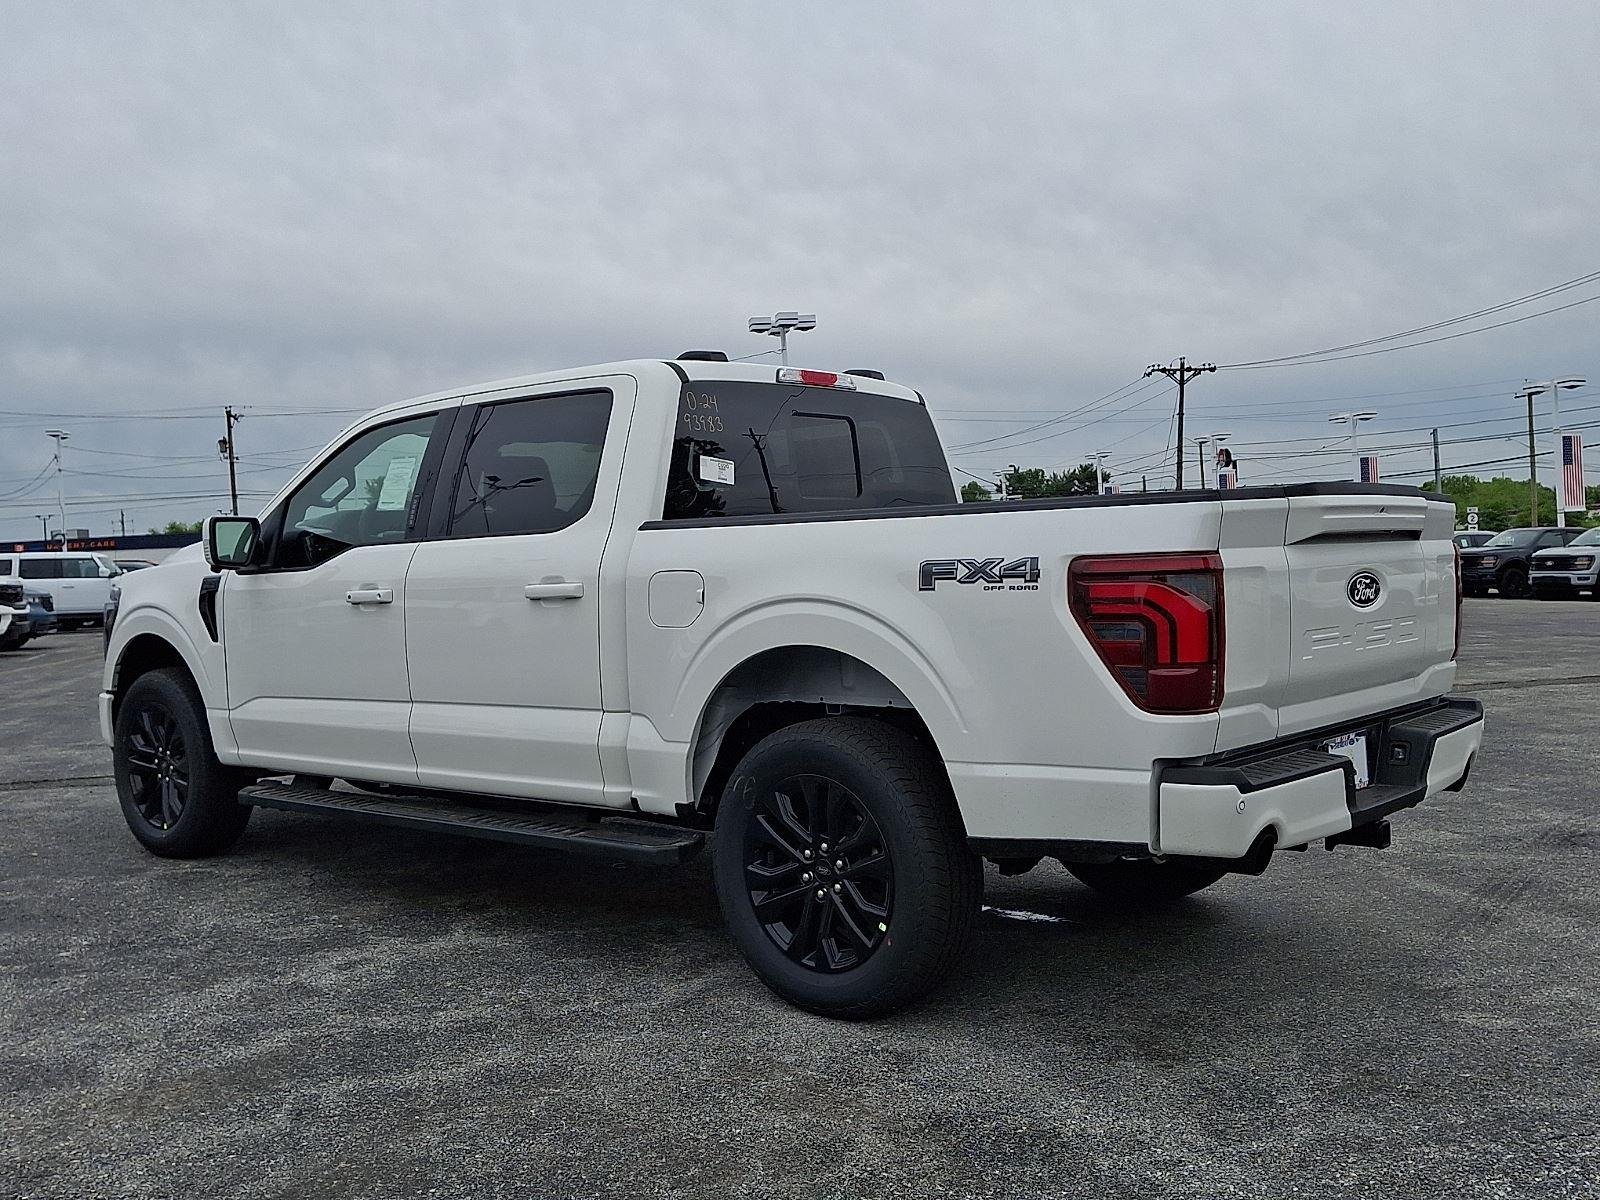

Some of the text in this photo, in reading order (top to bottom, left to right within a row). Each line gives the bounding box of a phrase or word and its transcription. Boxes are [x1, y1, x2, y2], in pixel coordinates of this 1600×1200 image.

[684, 413, 724, 432] 93983
[919, 557, 1040, 591] FX4
[1354, 578, 1376, 600] Ford
